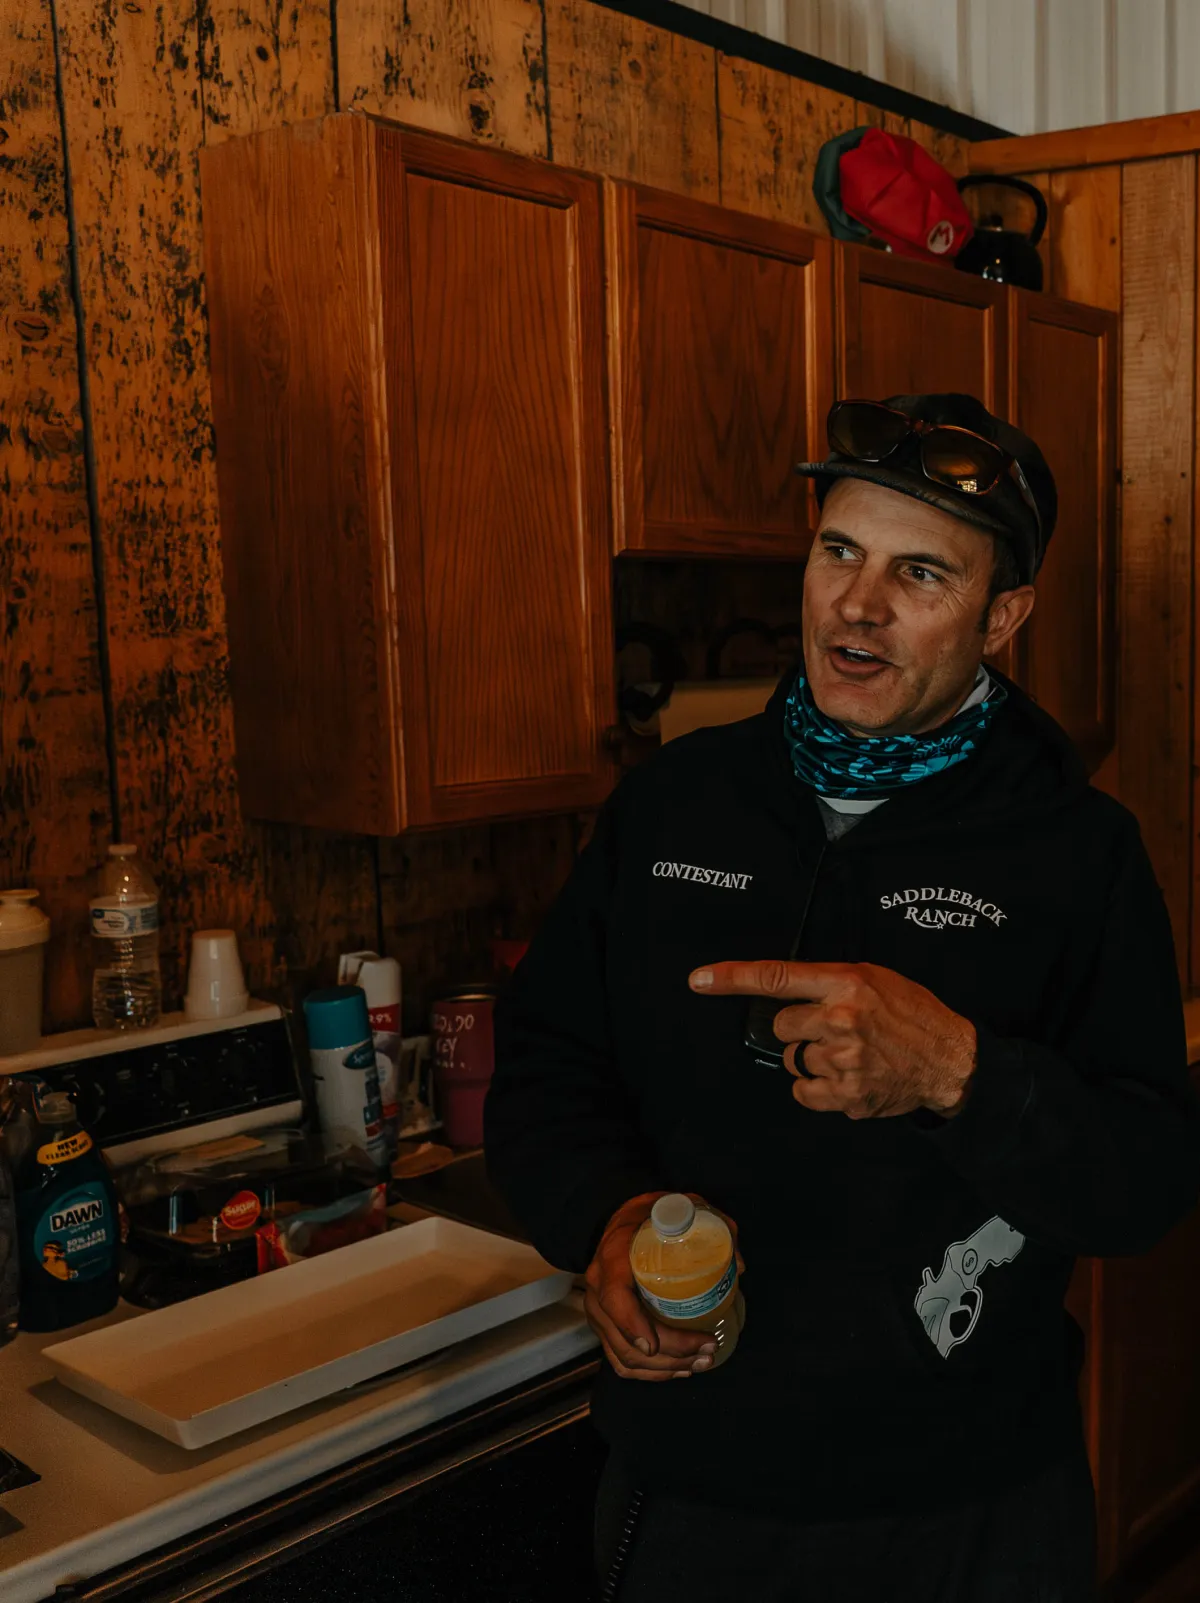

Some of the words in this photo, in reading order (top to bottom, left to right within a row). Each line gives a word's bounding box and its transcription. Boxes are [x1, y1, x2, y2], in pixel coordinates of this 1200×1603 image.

[652, 861, 753, 890] CONTESTANT
[880, 887, 1008, 927] SADDLEBACK
[904, 906, 978, 929] RANCH
[57, 1138, 78, 1151] NEW
[51, 1201, 104, 1232] DAWN
